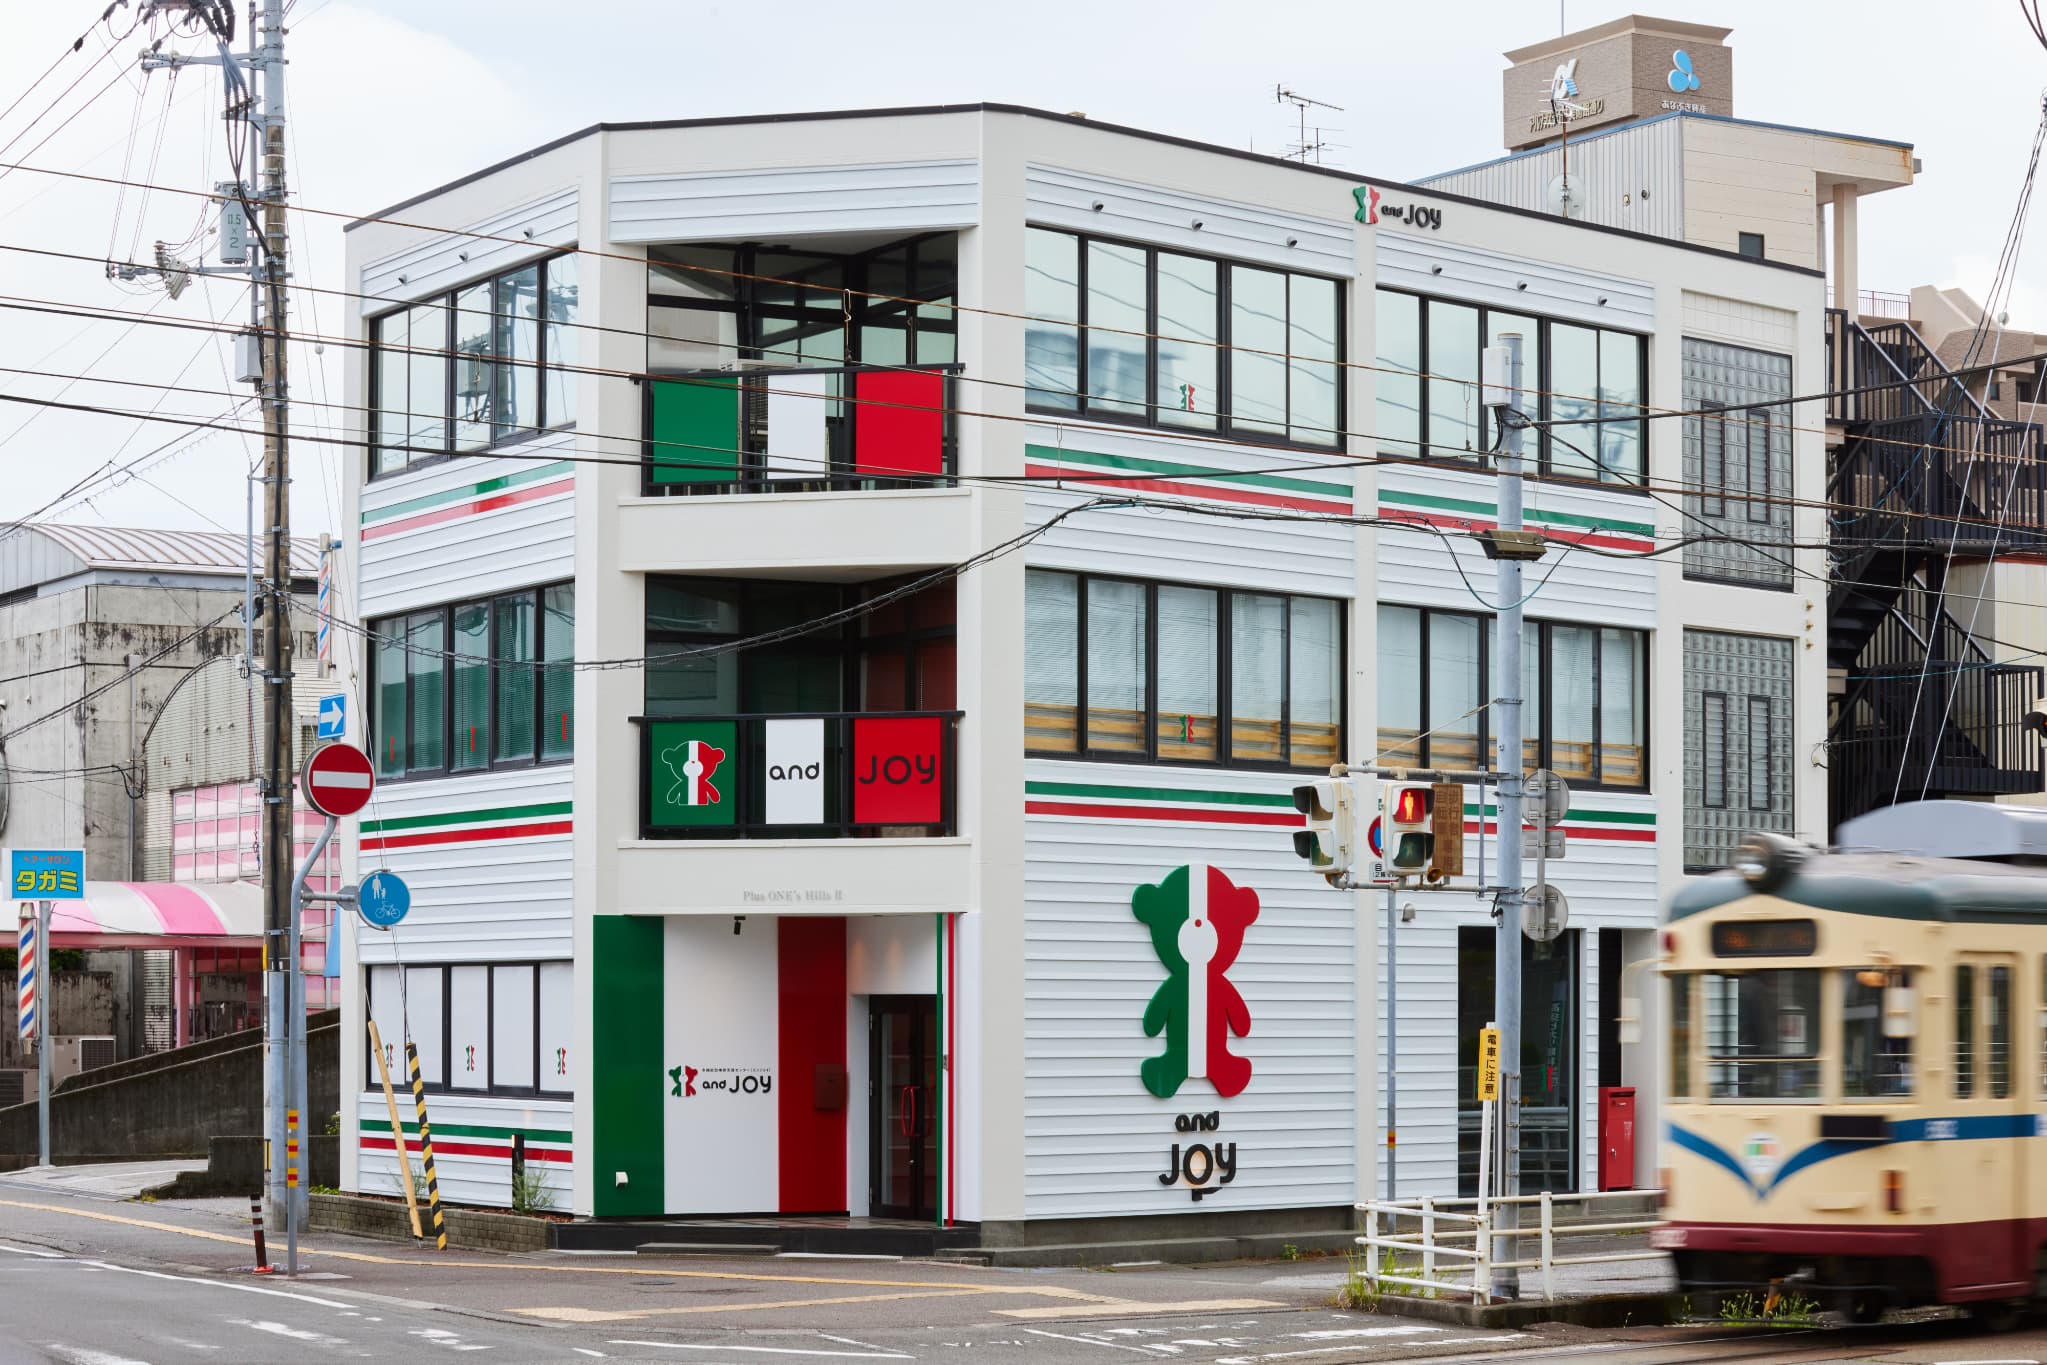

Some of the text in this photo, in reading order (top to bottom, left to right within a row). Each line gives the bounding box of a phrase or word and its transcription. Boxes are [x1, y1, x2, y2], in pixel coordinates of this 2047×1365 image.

[1381, 204, 1442, 230] and JOY
[229, 237, 239, 248] 2
[769, 755, 936, 785] and JOY
[16, 869, 79, 892] タガミ
[743, 889, 766, 902] Plus
[1484, 1034, 1497, 1094] 電車に注意
[702, 1075, 772, 1094] and JOY
[1175, 1110, 1220, 1132] and
[1158, 1143, 1237, 1186] JOY
